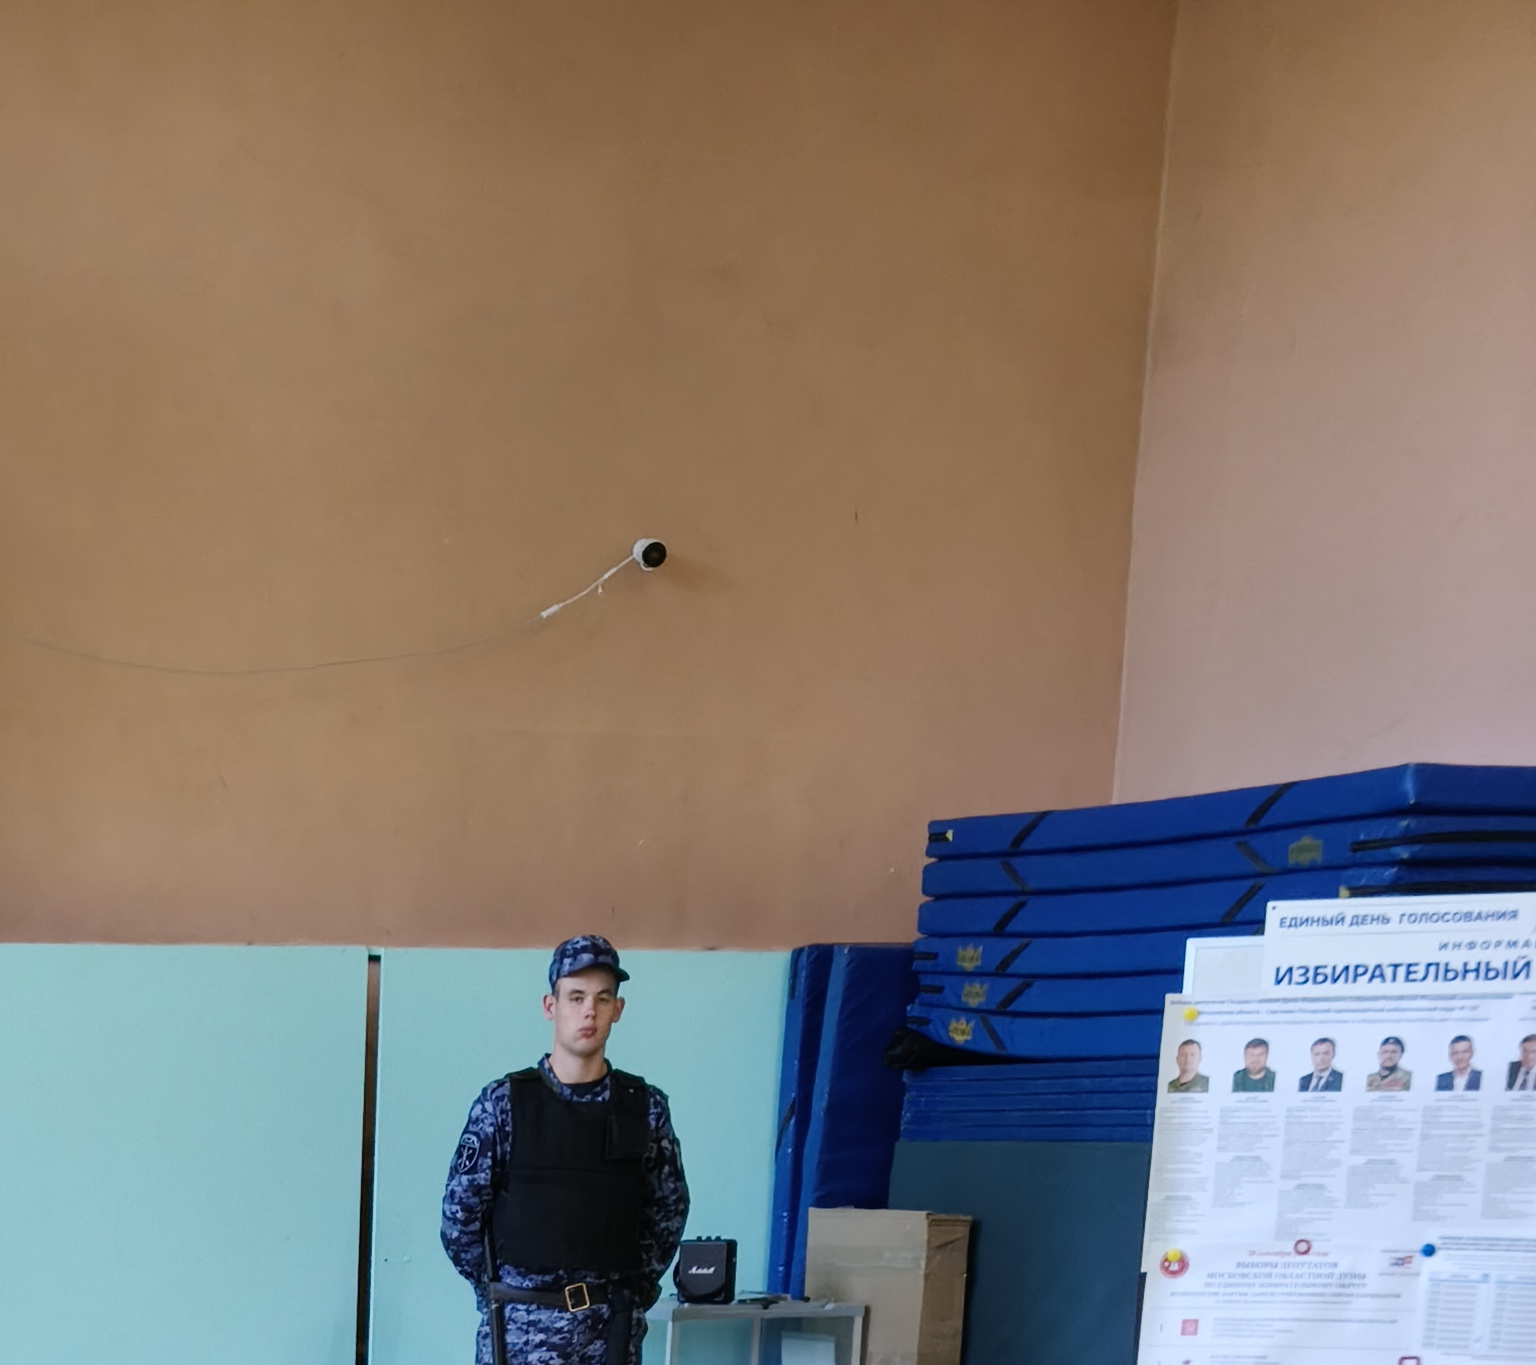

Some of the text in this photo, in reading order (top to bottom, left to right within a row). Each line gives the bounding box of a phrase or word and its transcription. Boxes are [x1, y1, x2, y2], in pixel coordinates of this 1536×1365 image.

[1279, 909, 1518, 929] ЕДИНЫЙ ДЕНЬ ГОЛОСОВАНИЯ
[1438, 940, 1536, 951] ИНФОРМА
[1274, 956, 1531, 986] ИЗБИРАТЕЛЬНЫЙ
